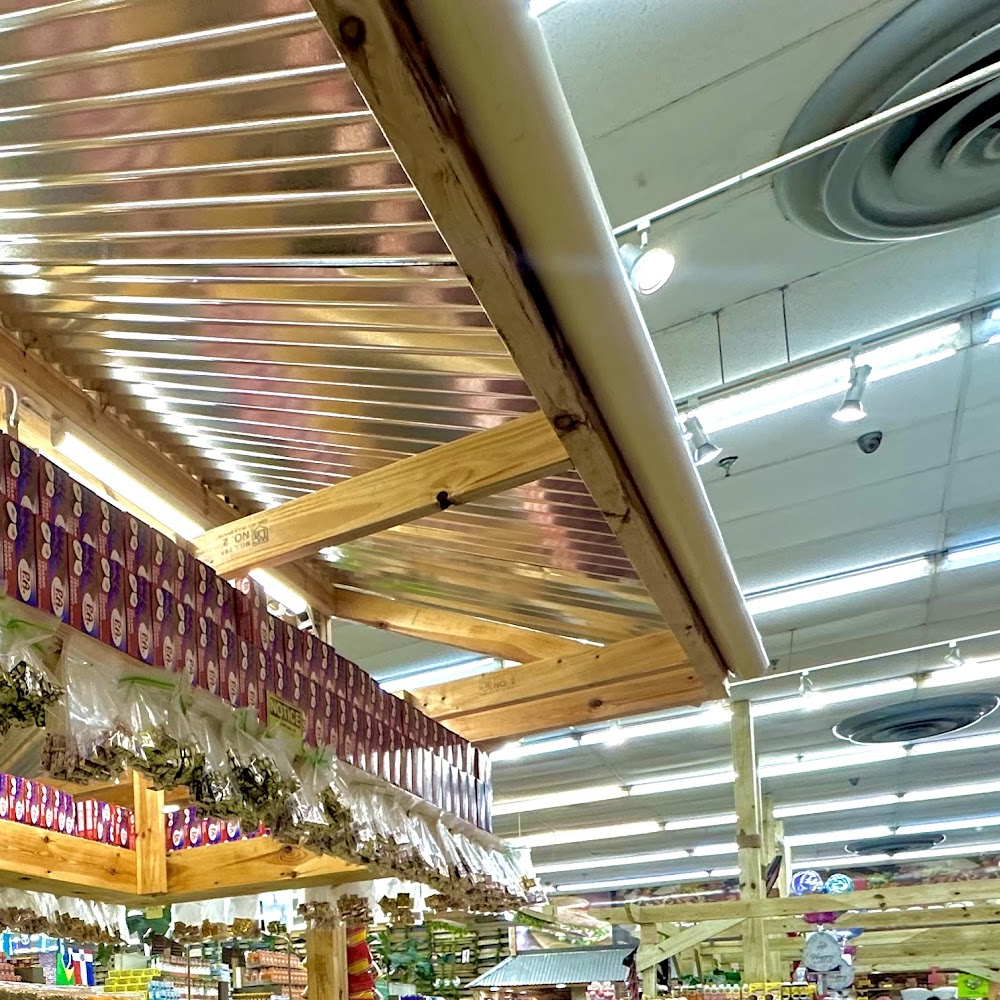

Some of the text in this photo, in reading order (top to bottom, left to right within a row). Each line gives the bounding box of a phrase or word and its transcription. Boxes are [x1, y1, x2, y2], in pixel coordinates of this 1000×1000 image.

[22, 570, 31, 594] P.A.
[55, 588, 64, 611] P.A.
[86, 603, 94, 626] P.A.
[270, 699, 301, 727] NOTICE
